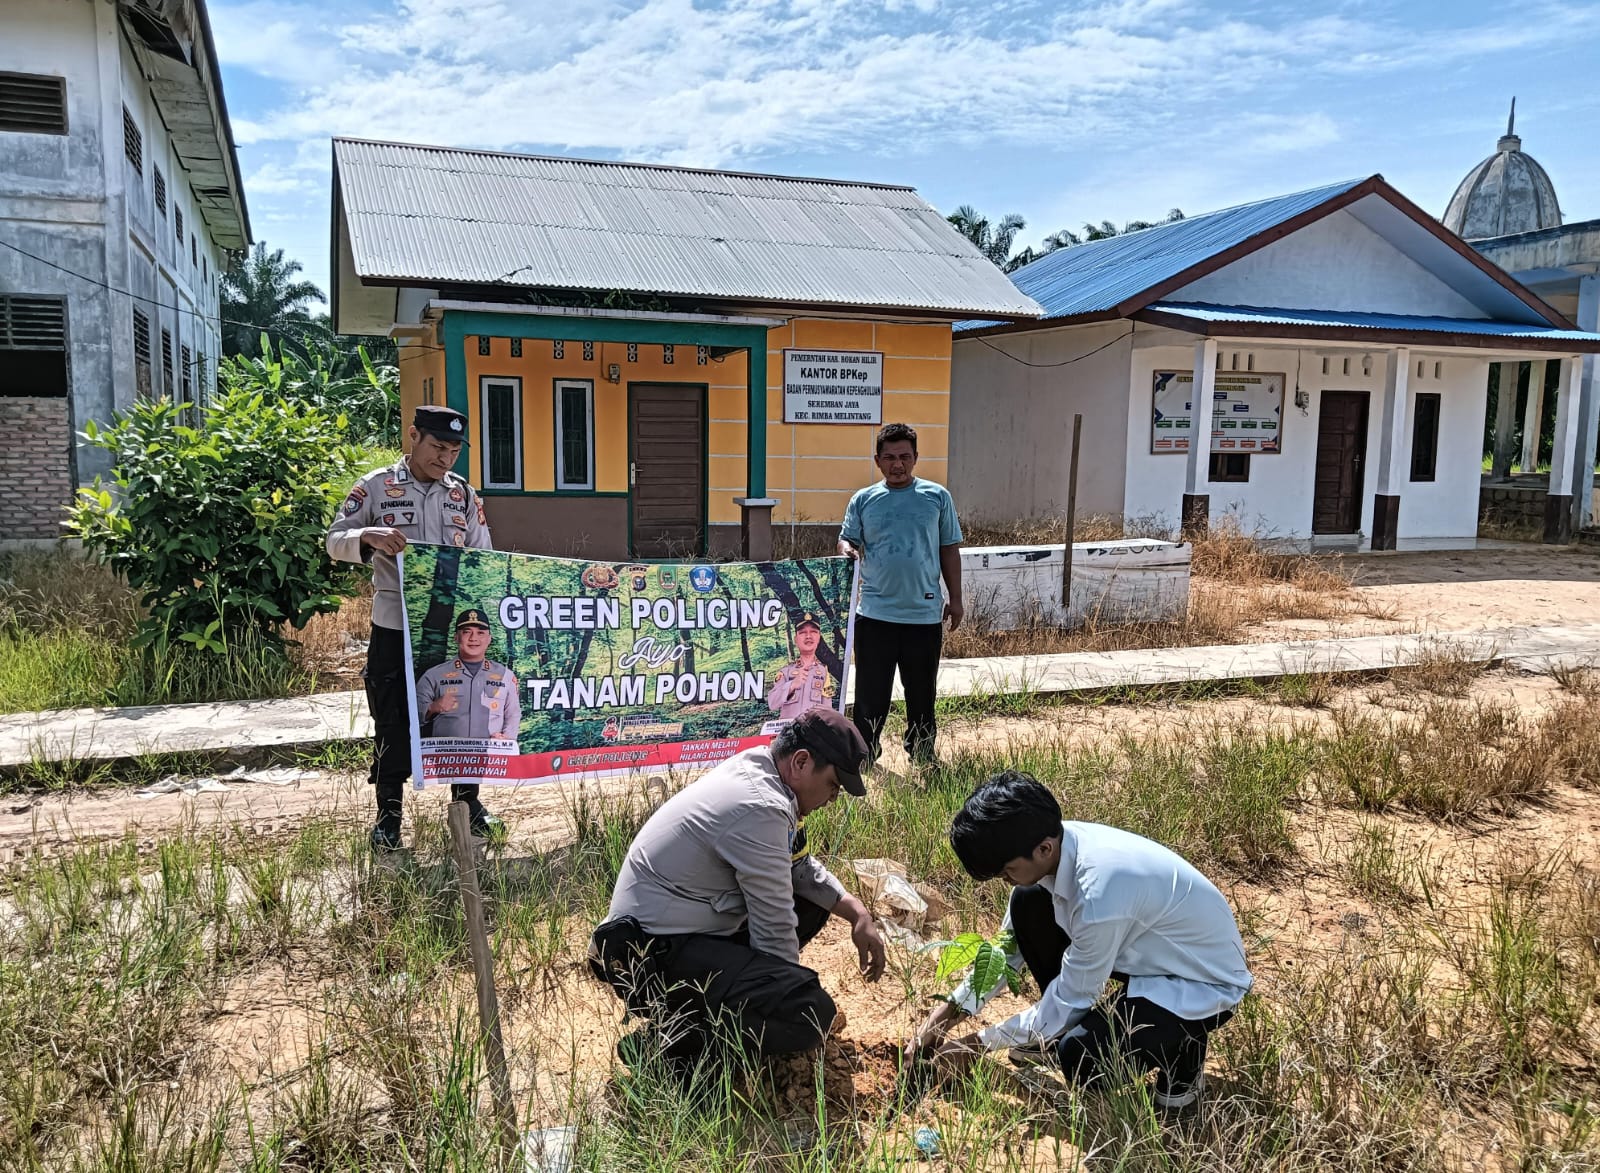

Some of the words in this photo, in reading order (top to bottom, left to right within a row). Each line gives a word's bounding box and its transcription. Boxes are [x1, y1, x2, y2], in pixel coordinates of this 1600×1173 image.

[841, 355, 860, 364] ROKAN
[800, 368, 838, 379] KANTOR
[840, 368, 868, 382] BPKep
[787, 384, 801, 394] BADAN
[844, 401, 860, 409] JAYA
[811, 412, 833, 420] RIMBA
[834, 412, 872, 420] MELINTANG
[499, 595, 621, 630] GREEN
[631, 597, 783, 630] POLICING
[618, 636, 692, 670] Ayo
[526, 674, 645, 710] TANAM
[655, 670, 765, 704] POHON
[681, 742, 710, 752] TAKKAN
[711, 740, 740, 749] MELAYU
[568, 754, 600, 766] GREEN
[602, 750, 648, 764] POLICING
[680, 751, 707, 760] HILANG
[483, 757, 508, 766] TUAH
[462, 766, 507, 776] MARWAH
